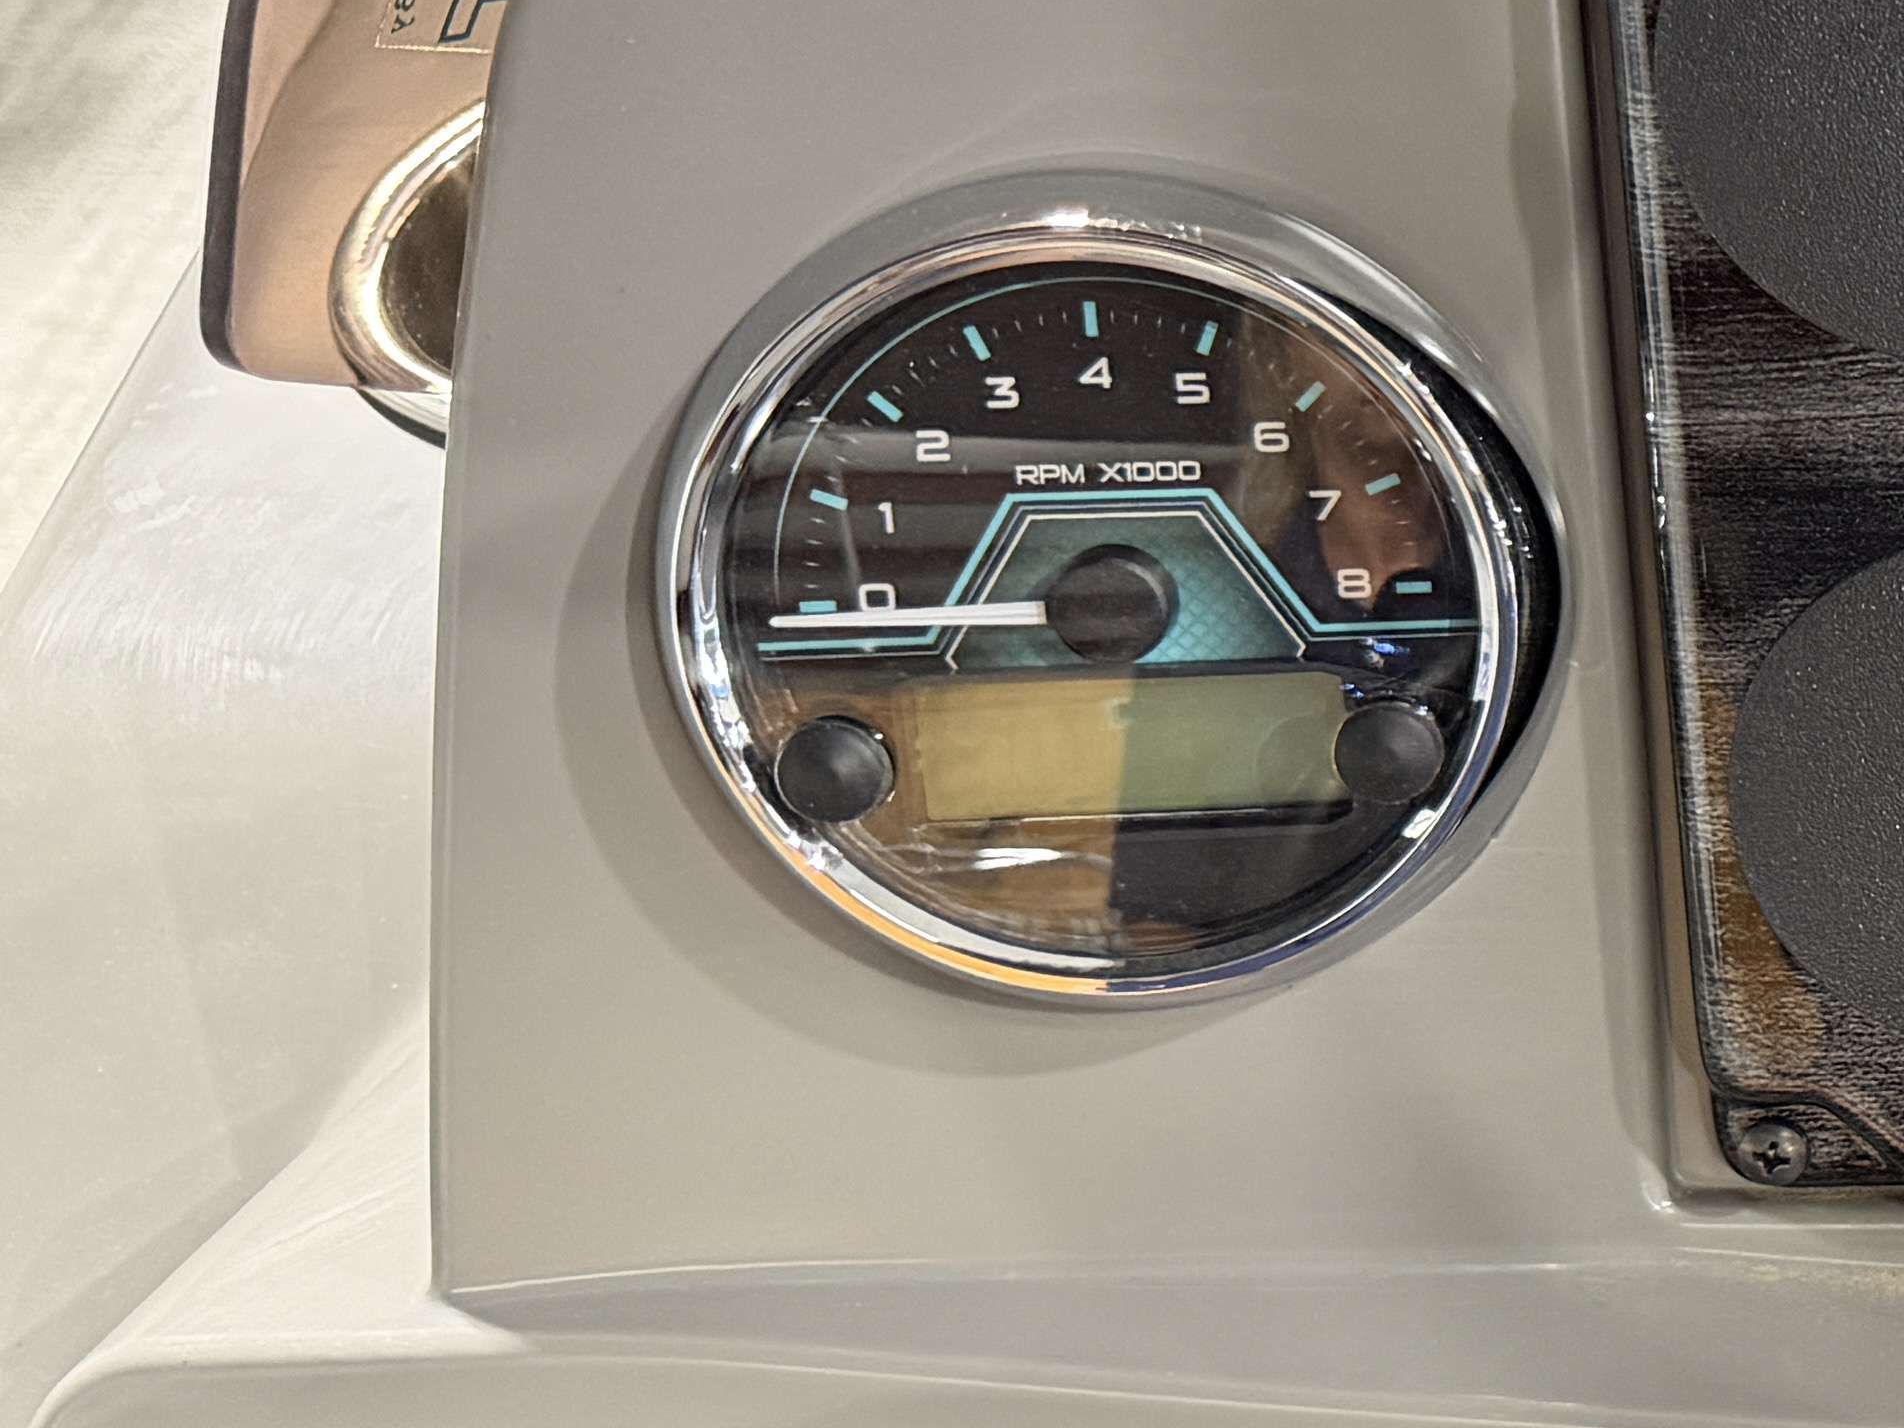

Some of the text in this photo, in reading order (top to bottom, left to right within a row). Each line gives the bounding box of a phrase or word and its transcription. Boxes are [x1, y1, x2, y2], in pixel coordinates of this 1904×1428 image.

[1079, 357, 1113, 389] 4
[1175, 372, 1211, 405] 5
[985, 376, 1020, 409] 3
[915, 429, 952, 462] 2
[1253, 421, 1290, 453] 6
[1015, 461, 1201, 486] RPM X1000
[878, 502, 896, 535] 1
[1308, 489, 1342, 522] 7
[858, 582, 897, 612] 0
[1337, 568, 1373, 599] 8
